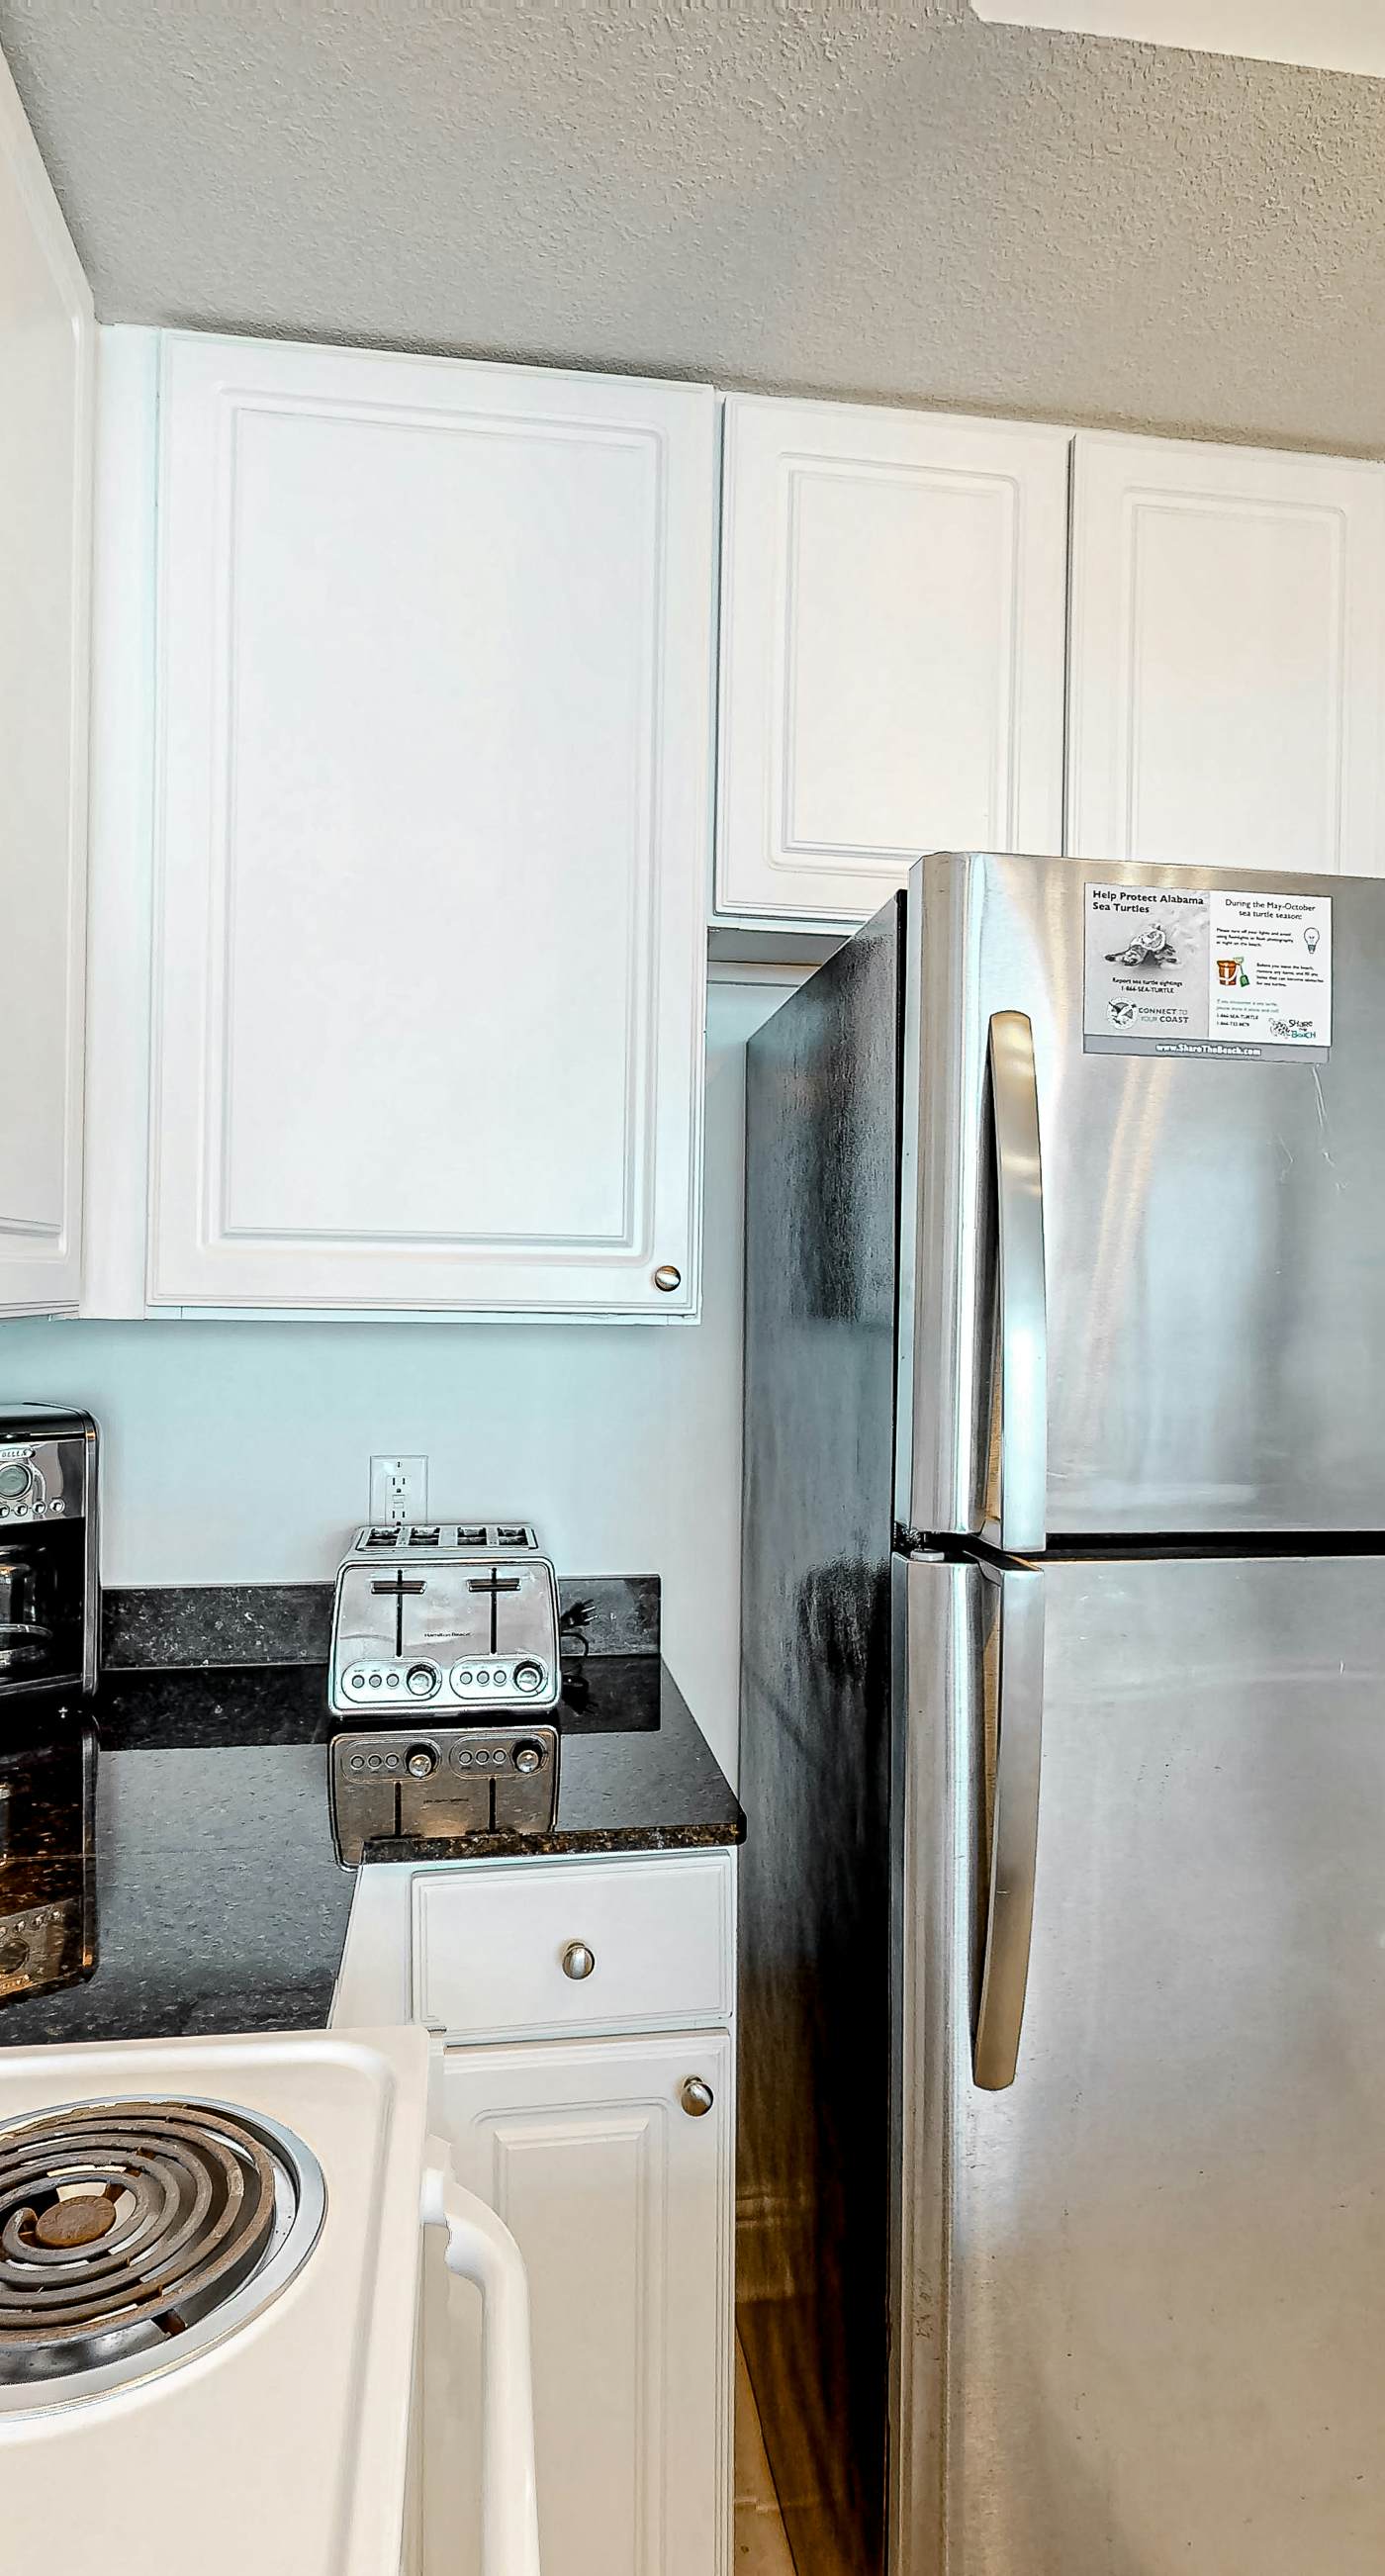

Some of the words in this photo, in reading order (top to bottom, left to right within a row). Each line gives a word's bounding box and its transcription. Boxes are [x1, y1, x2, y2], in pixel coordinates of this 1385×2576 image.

[1093, 890, 1116, 901] Help
[1120, 892, 1157, 902] Protect
[1160, 895, 1204, 904] Alabama
[1093, 902, 1110, 910] Sea
[1113, 903, 1150, 913] Turtles
[1225, 899, 1251, 908] During
[1267, 902, 1315, 911] May-October
[1156, 1043, 1261, 1056] www.ShareTheBeach.com
